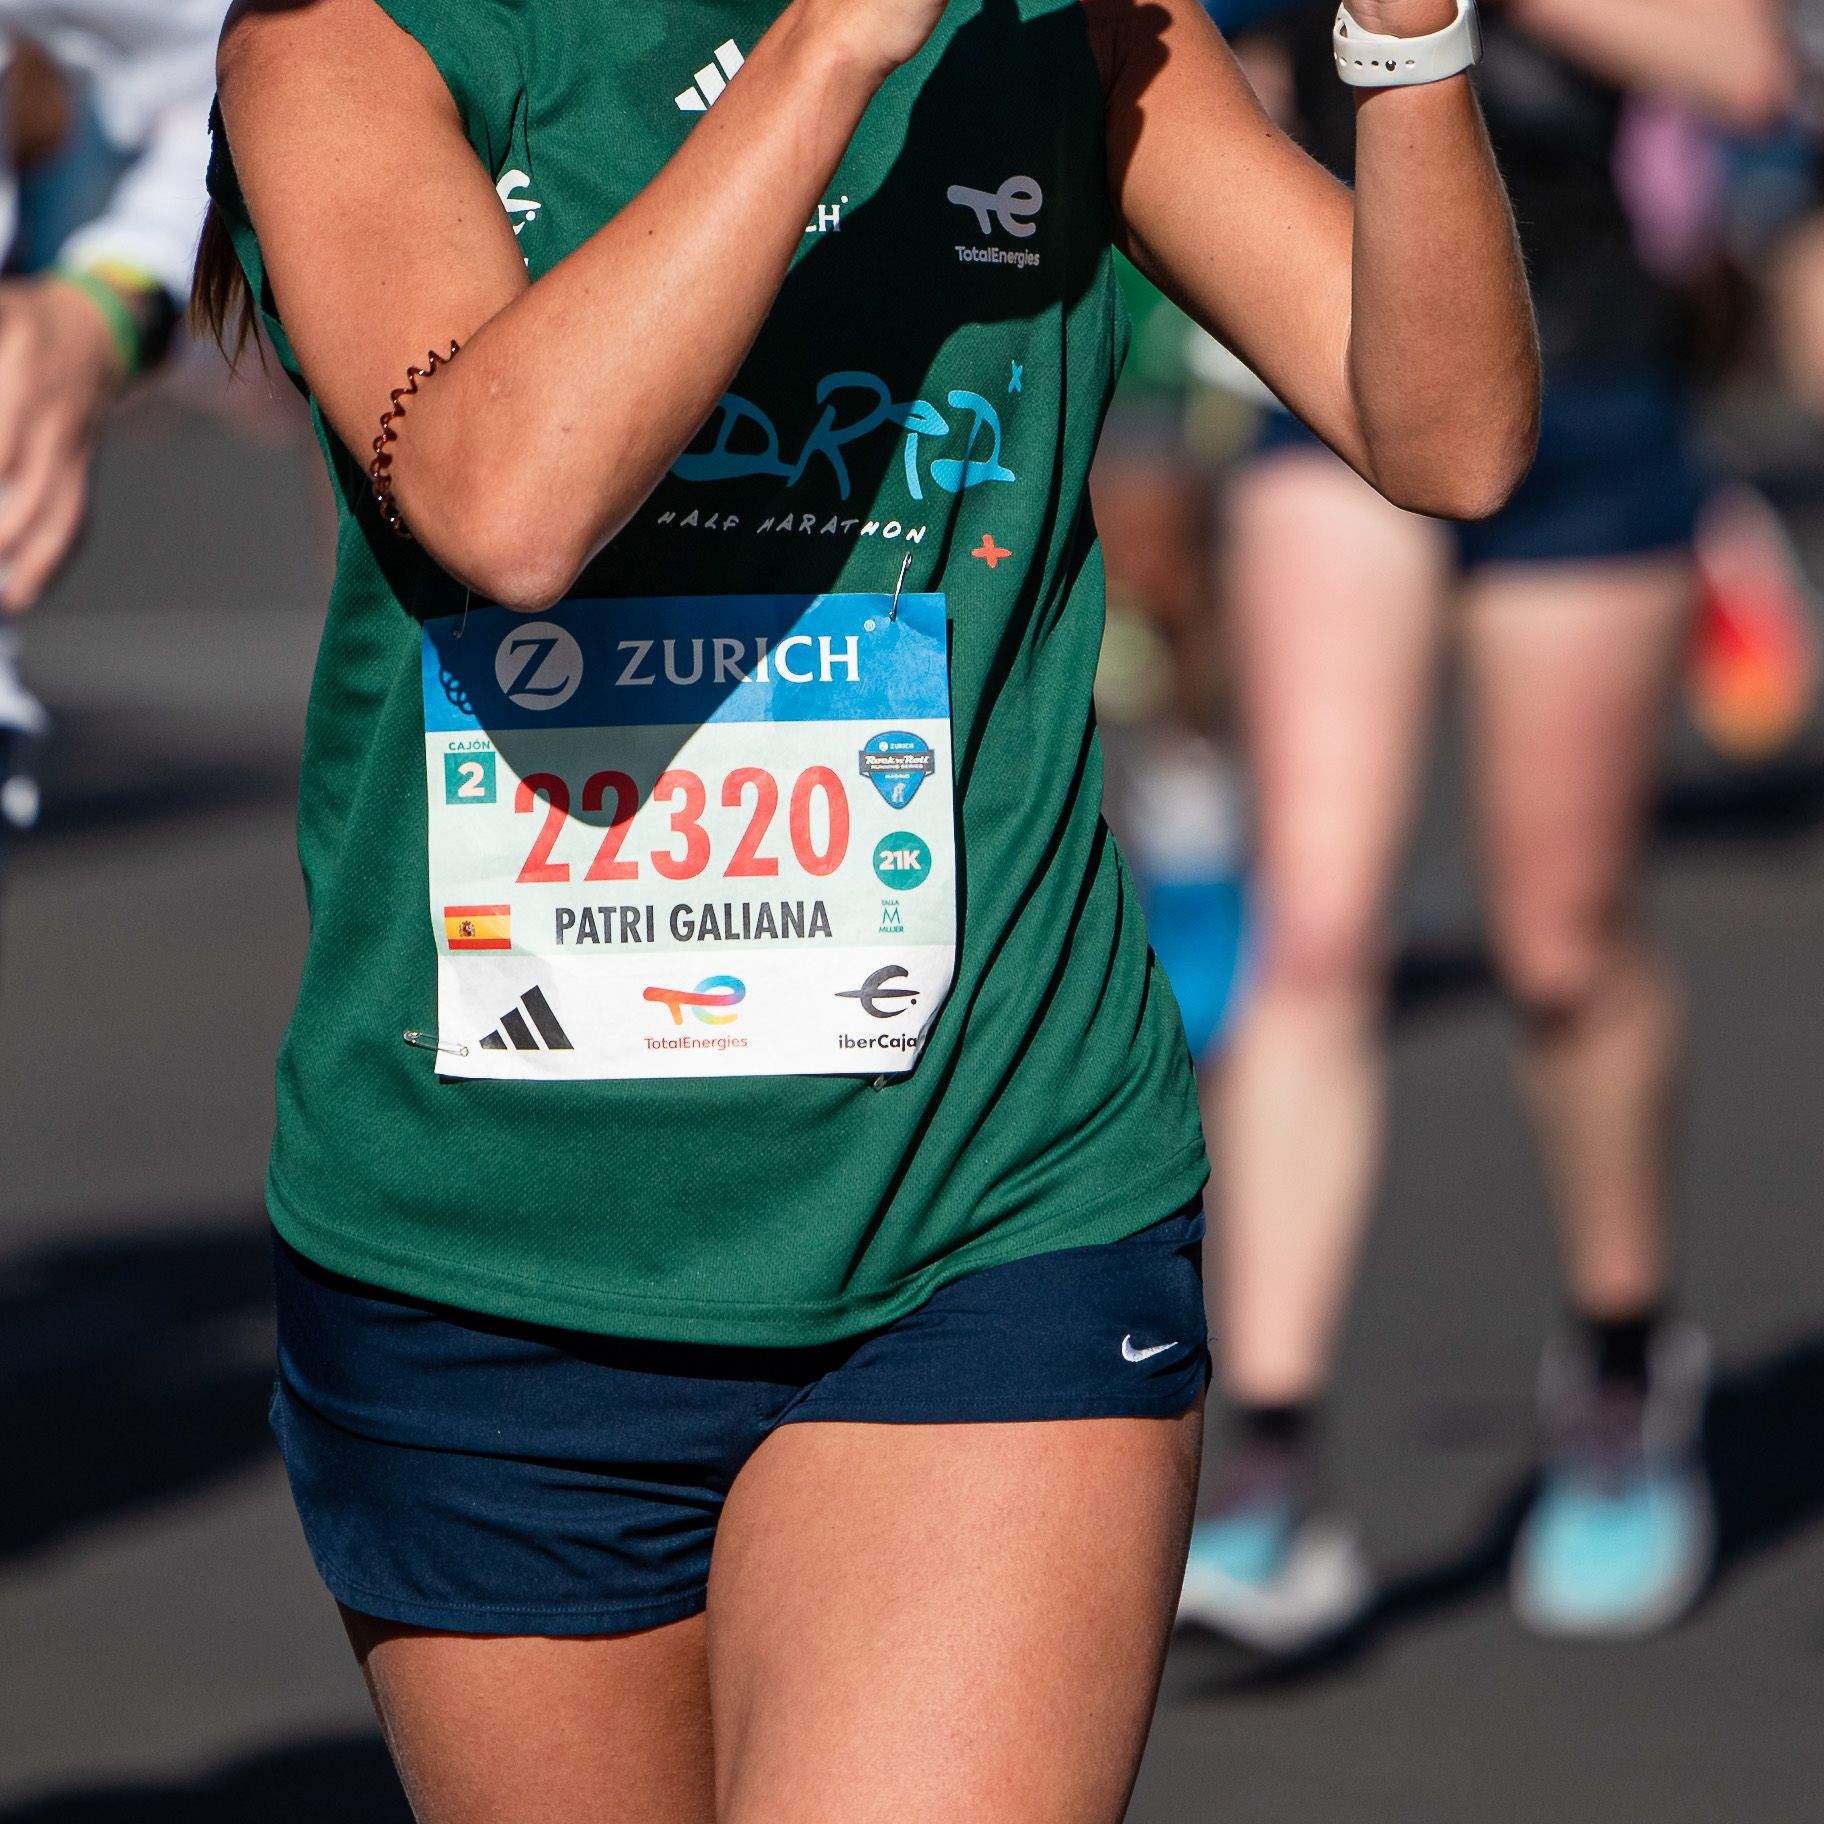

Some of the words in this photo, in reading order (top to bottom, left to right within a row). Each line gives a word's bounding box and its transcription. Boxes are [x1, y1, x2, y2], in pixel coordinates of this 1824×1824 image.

[954, 245, 1041, 269] TotalEnergies
[670, 371, 1017, 501] DRID
[658, 509, 739, 531] HALF
[757, 514, 926, 544] MARATHON
[616, 635, 860, 686] ZURICH
[449, 739, 490, 750] CAJÓN
[458, 761, 485, 797] 2
[514, 765, 850, 884] 22320
[879, 850, 921, 870] 21K
[555, 903, 654, 946] PATRI
[669, 900, 832, 942] GALIANA
[882, 907, 901, 924] M
[644, 1036, 748, 1051] TotalEnergies
[838, 1034, 918, 1052] iberCaja
